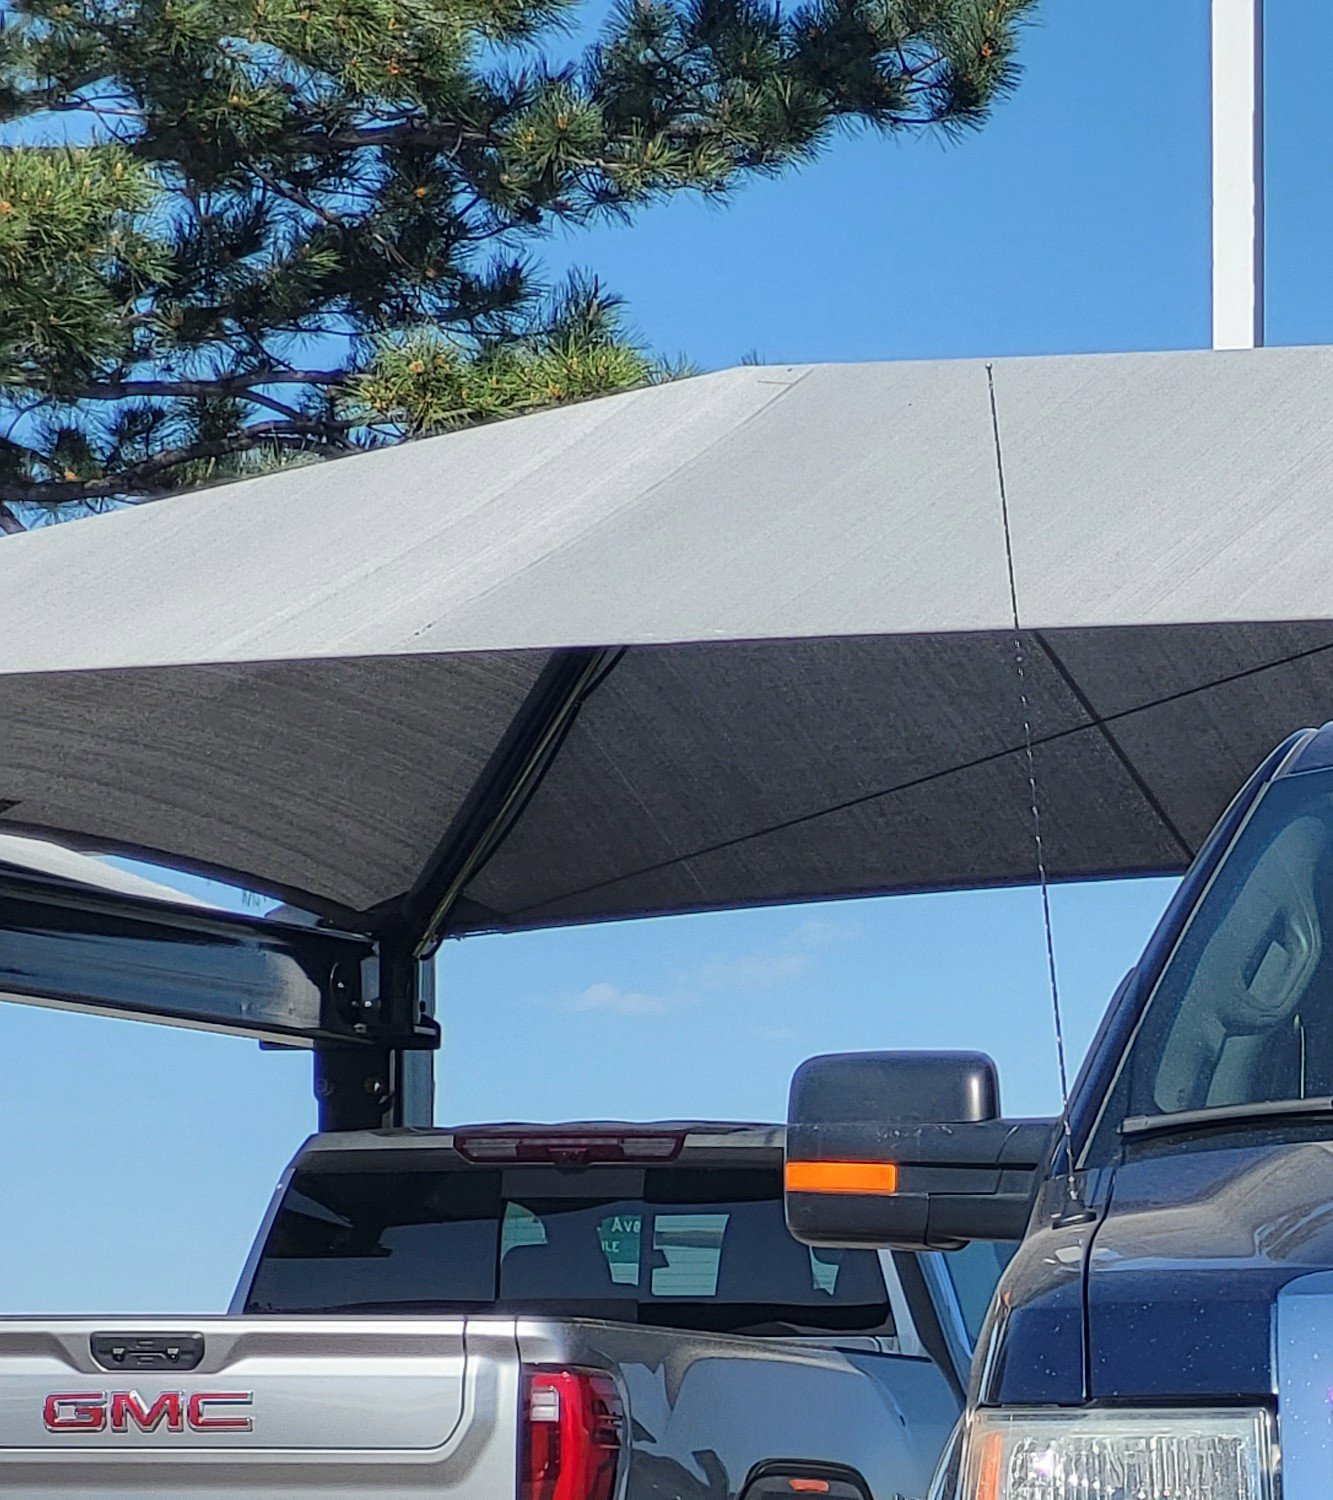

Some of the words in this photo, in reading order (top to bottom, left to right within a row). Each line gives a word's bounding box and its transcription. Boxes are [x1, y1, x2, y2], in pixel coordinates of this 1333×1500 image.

[611, 1216, 641, 1233] Ave
[601, 1240, 620, 1252] ILE
[43, 1390, 254, 1433] GMC
